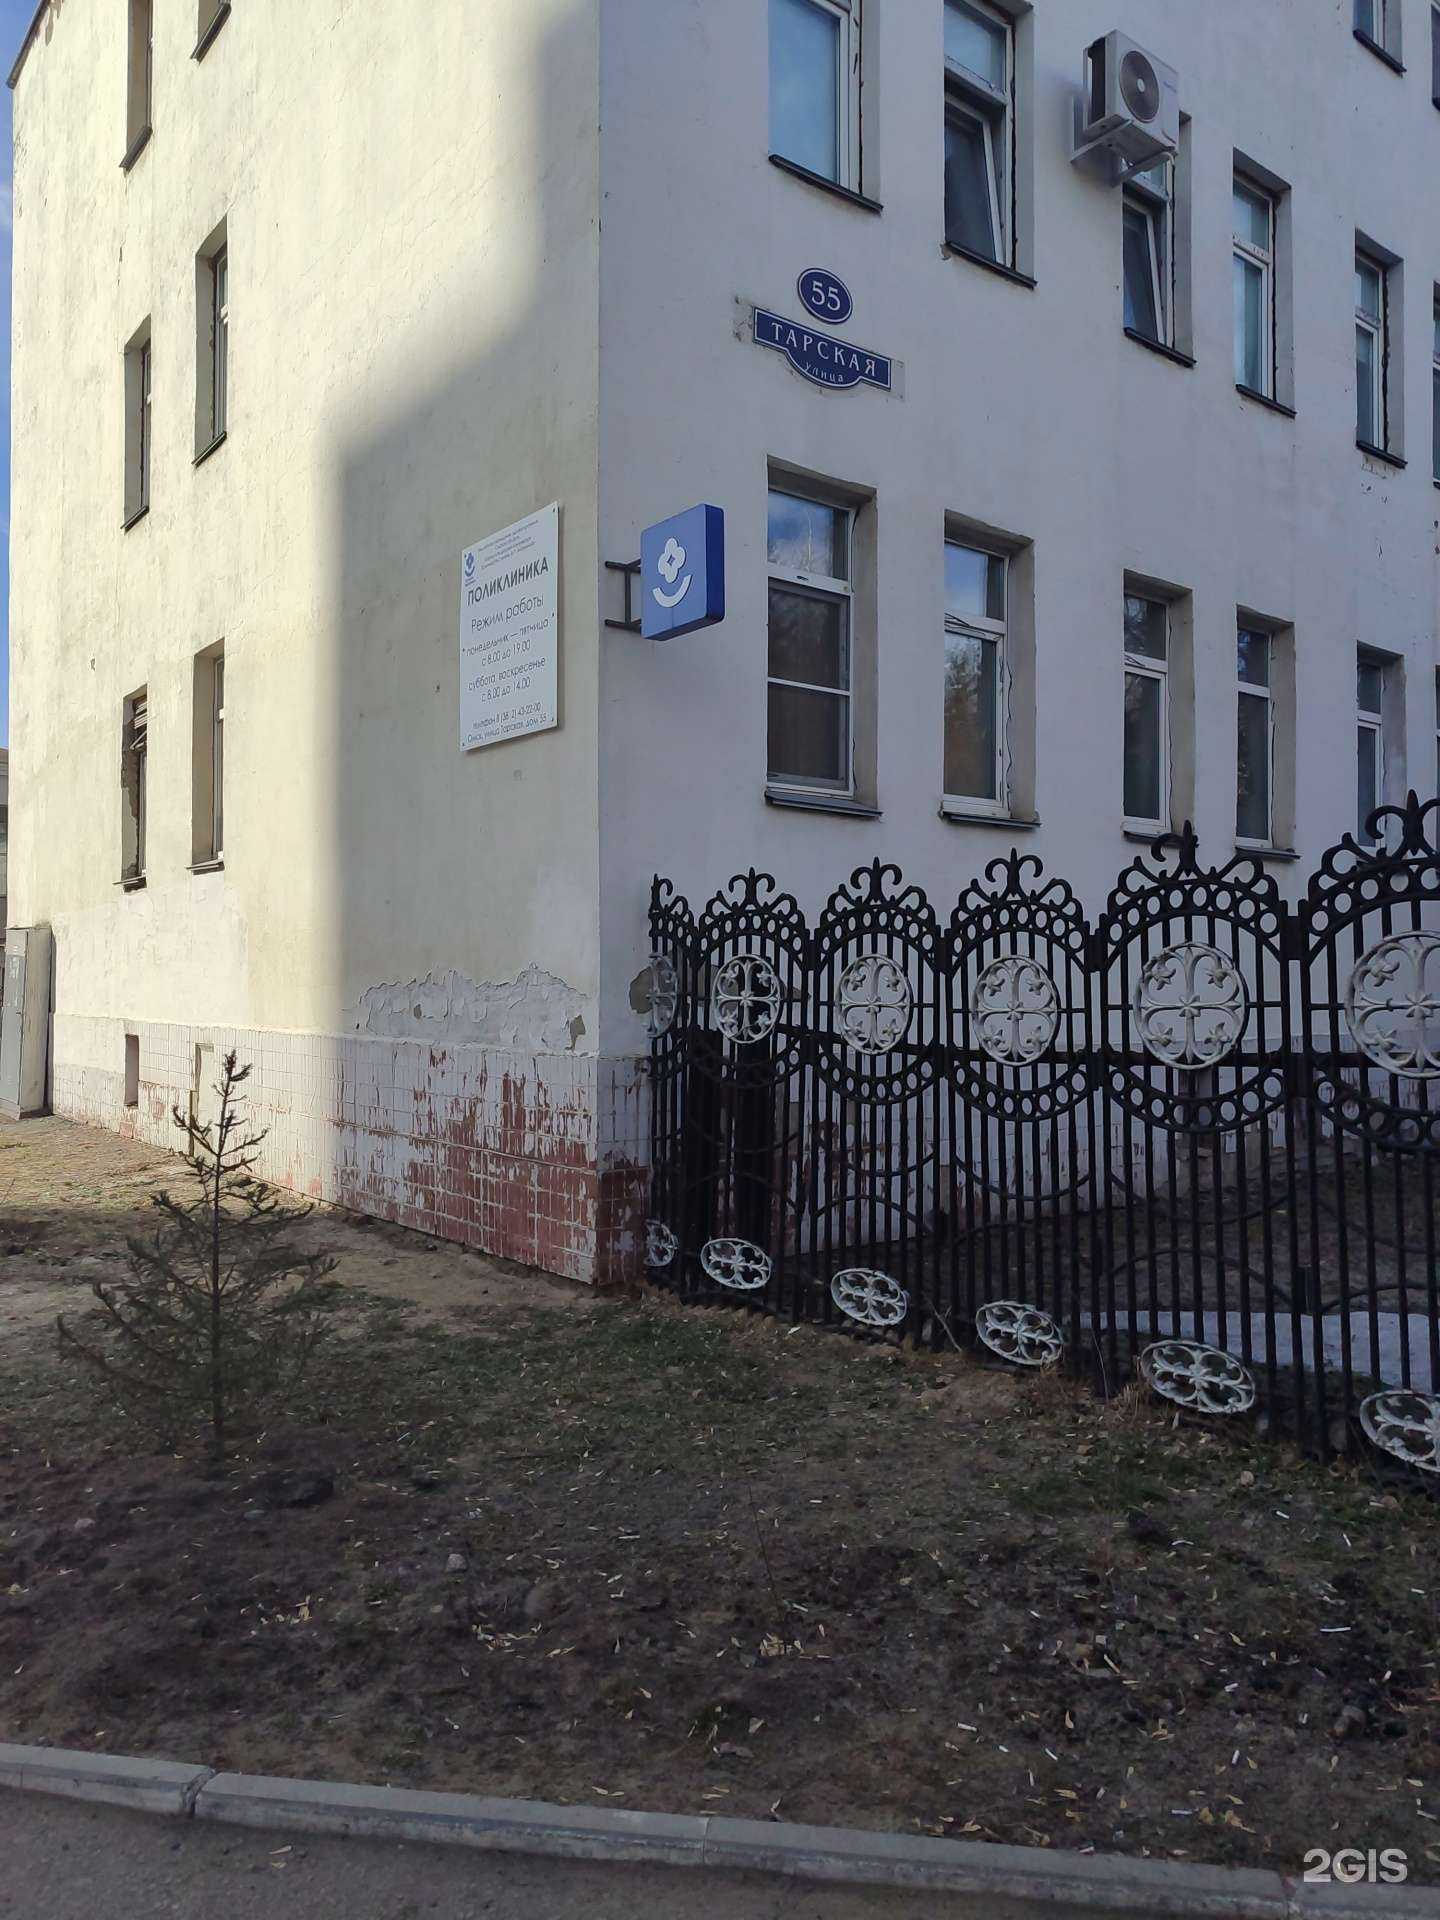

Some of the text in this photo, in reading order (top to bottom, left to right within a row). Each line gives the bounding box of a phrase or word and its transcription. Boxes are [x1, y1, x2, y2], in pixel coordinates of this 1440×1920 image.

[811, 280, 841, 311] 55
[771, 322, 876, 377] ТАРСКАЯ
[467, 556, 548, 607] ПОЛИКЛИНИКА
[471, 596, 544, 633] Режим работы
[466, 633, 508, 657] понедельник
[519, 618, 549, 637] пятница
[481, 639, 531, 666] с 8.00 до 19.00
[498, 657, 546, 681] воскресенье
[501, 685, 511, 697] до
